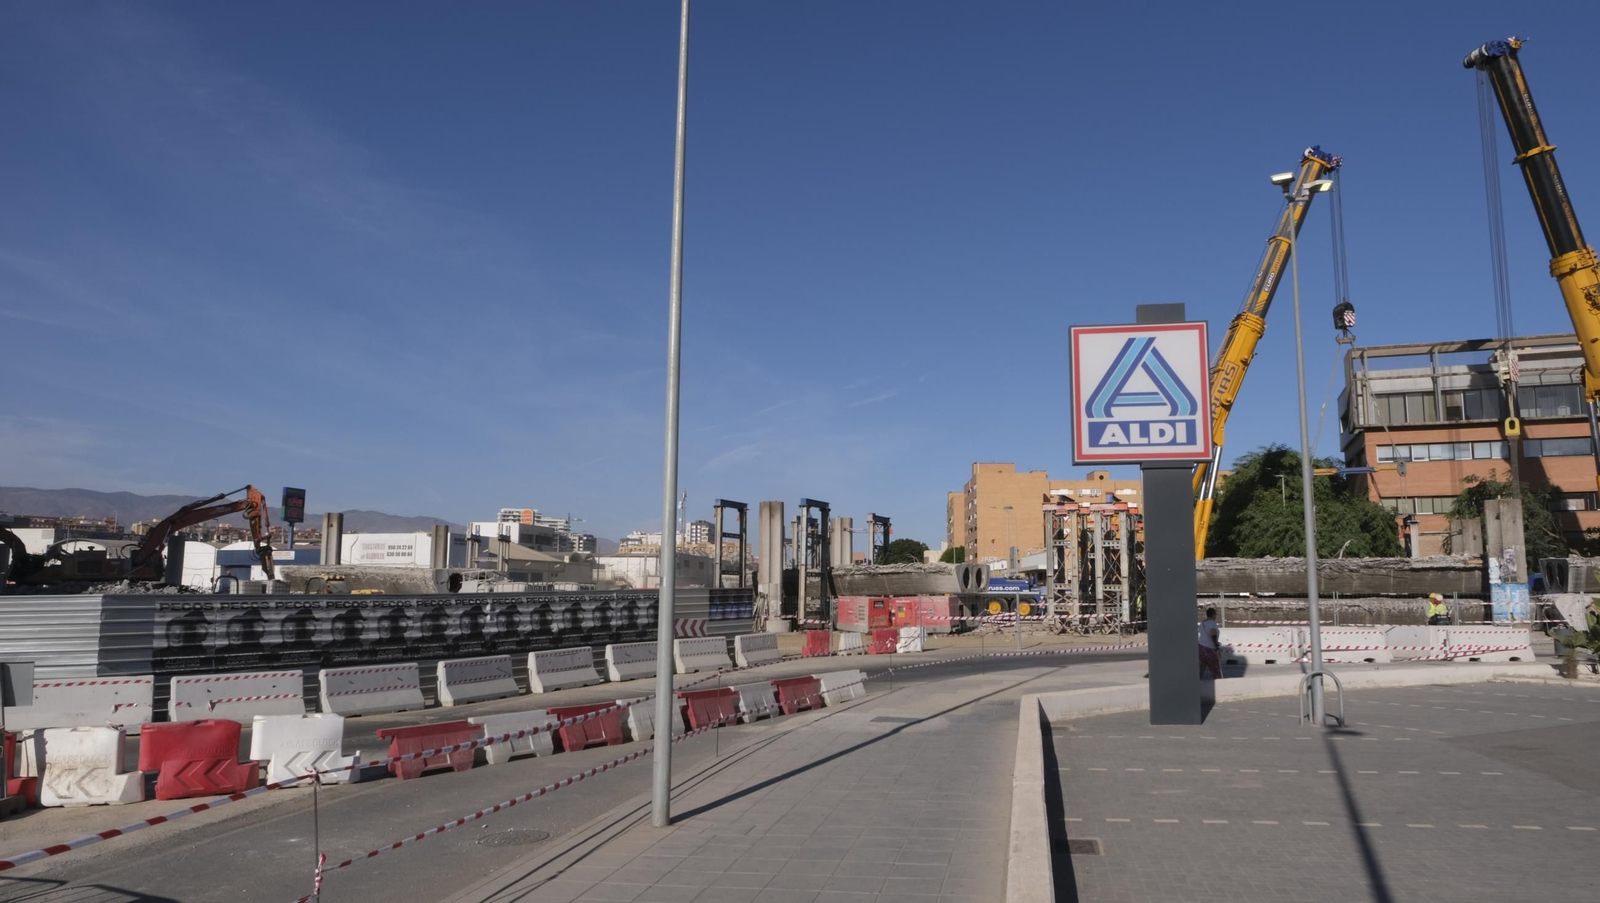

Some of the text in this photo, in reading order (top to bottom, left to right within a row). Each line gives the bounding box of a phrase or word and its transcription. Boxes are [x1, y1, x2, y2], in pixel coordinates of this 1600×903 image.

[1211, 365, 1236, 415] RUAS
[1098, 422, 1187, 444] ALDI
[526, 596, 556, 604] PECOS
[558, 595, 587, 603] PECOS
[159, 602, 215, 611] PECOS
[220, 601, 270, 610] PECOS
[275, 601, 321, 609] PECOS
[326, 600, 368, 608] PECOS
[372, 600, 412, 608] PECOS
